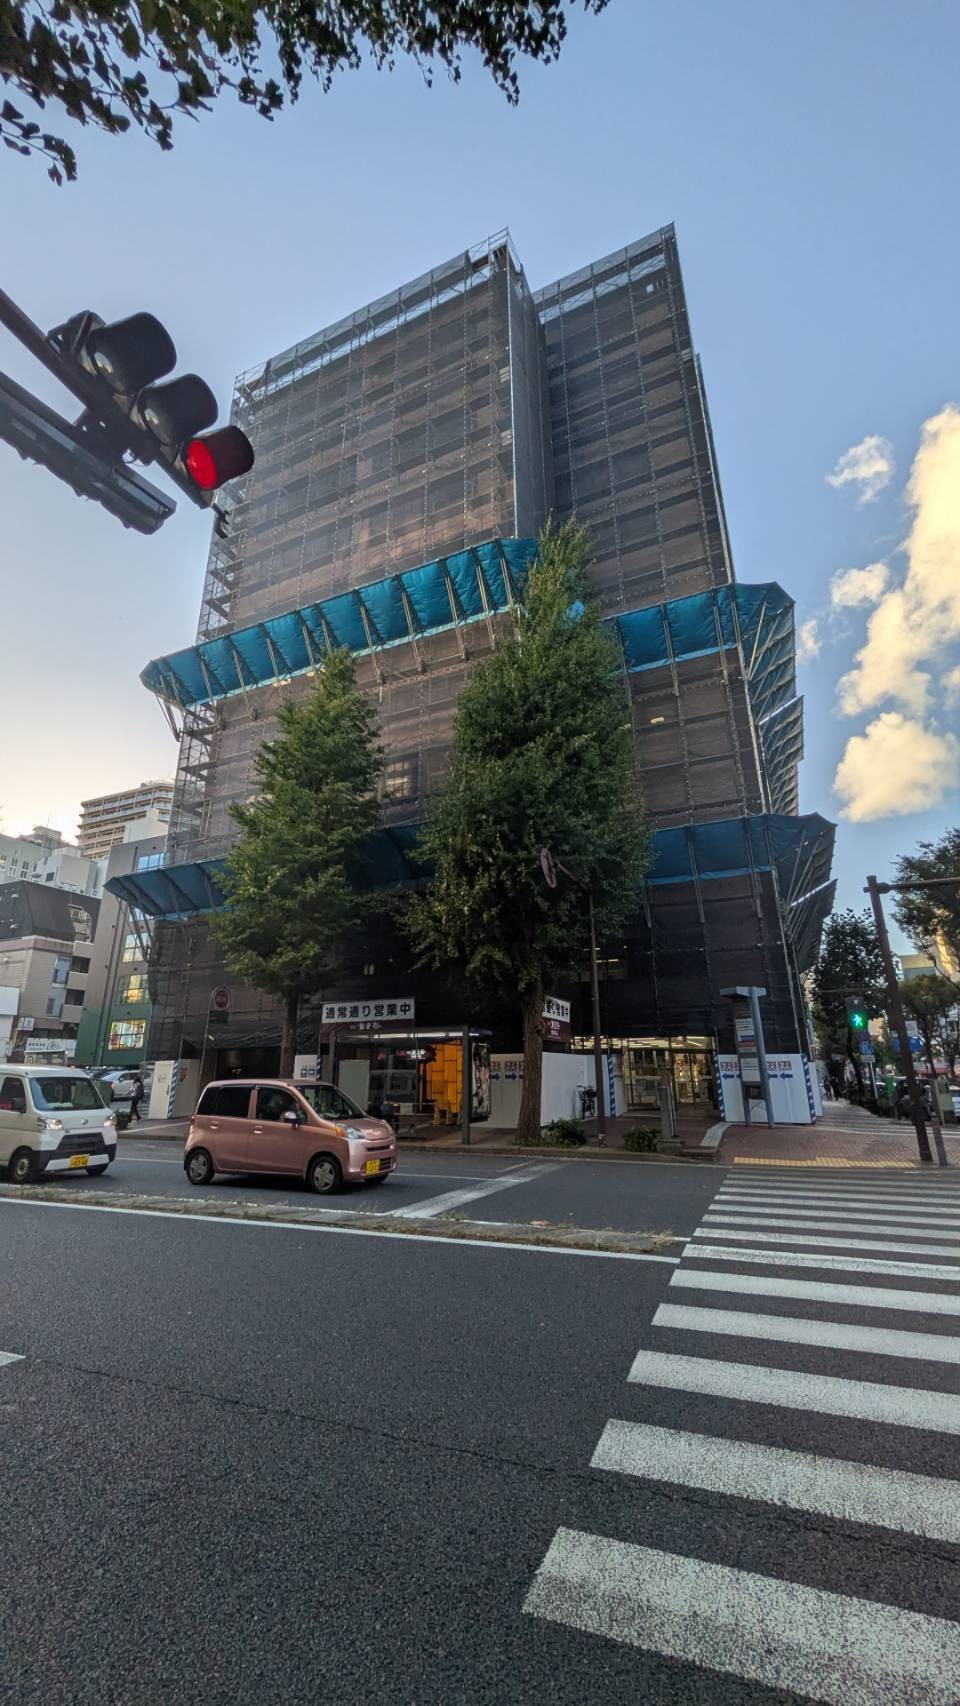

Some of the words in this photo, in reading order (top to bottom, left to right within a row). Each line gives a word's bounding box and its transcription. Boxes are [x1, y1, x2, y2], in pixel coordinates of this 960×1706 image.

[325, 1002, 411, 1019] 通常通り営業中
